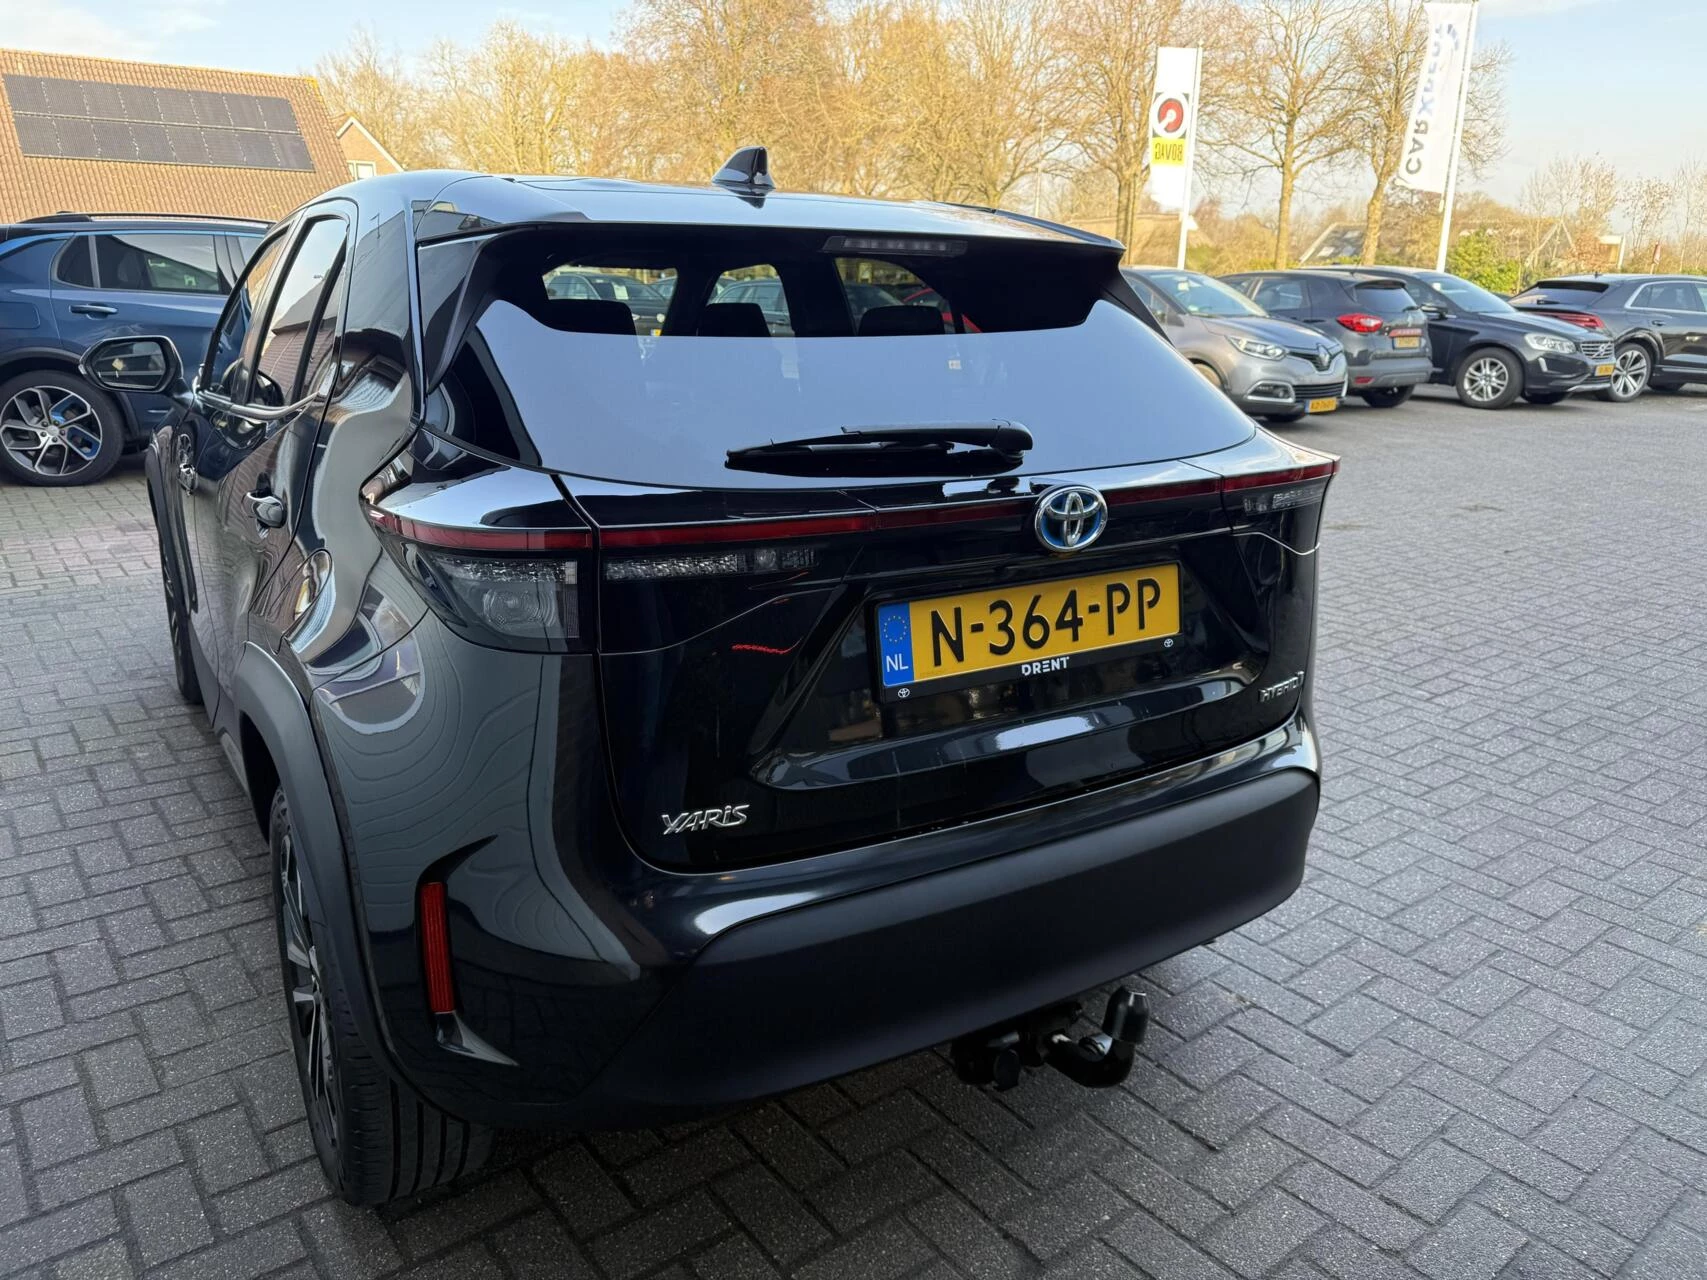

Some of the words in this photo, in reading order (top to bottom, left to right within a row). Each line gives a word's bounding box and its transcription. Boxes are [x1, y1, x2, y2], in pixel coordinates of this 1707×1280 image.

[885, 653, 909, 673] NL
[930, 577, 1162, 667] N-364-PP
[1021, 656, 1070, 676] DRENT
